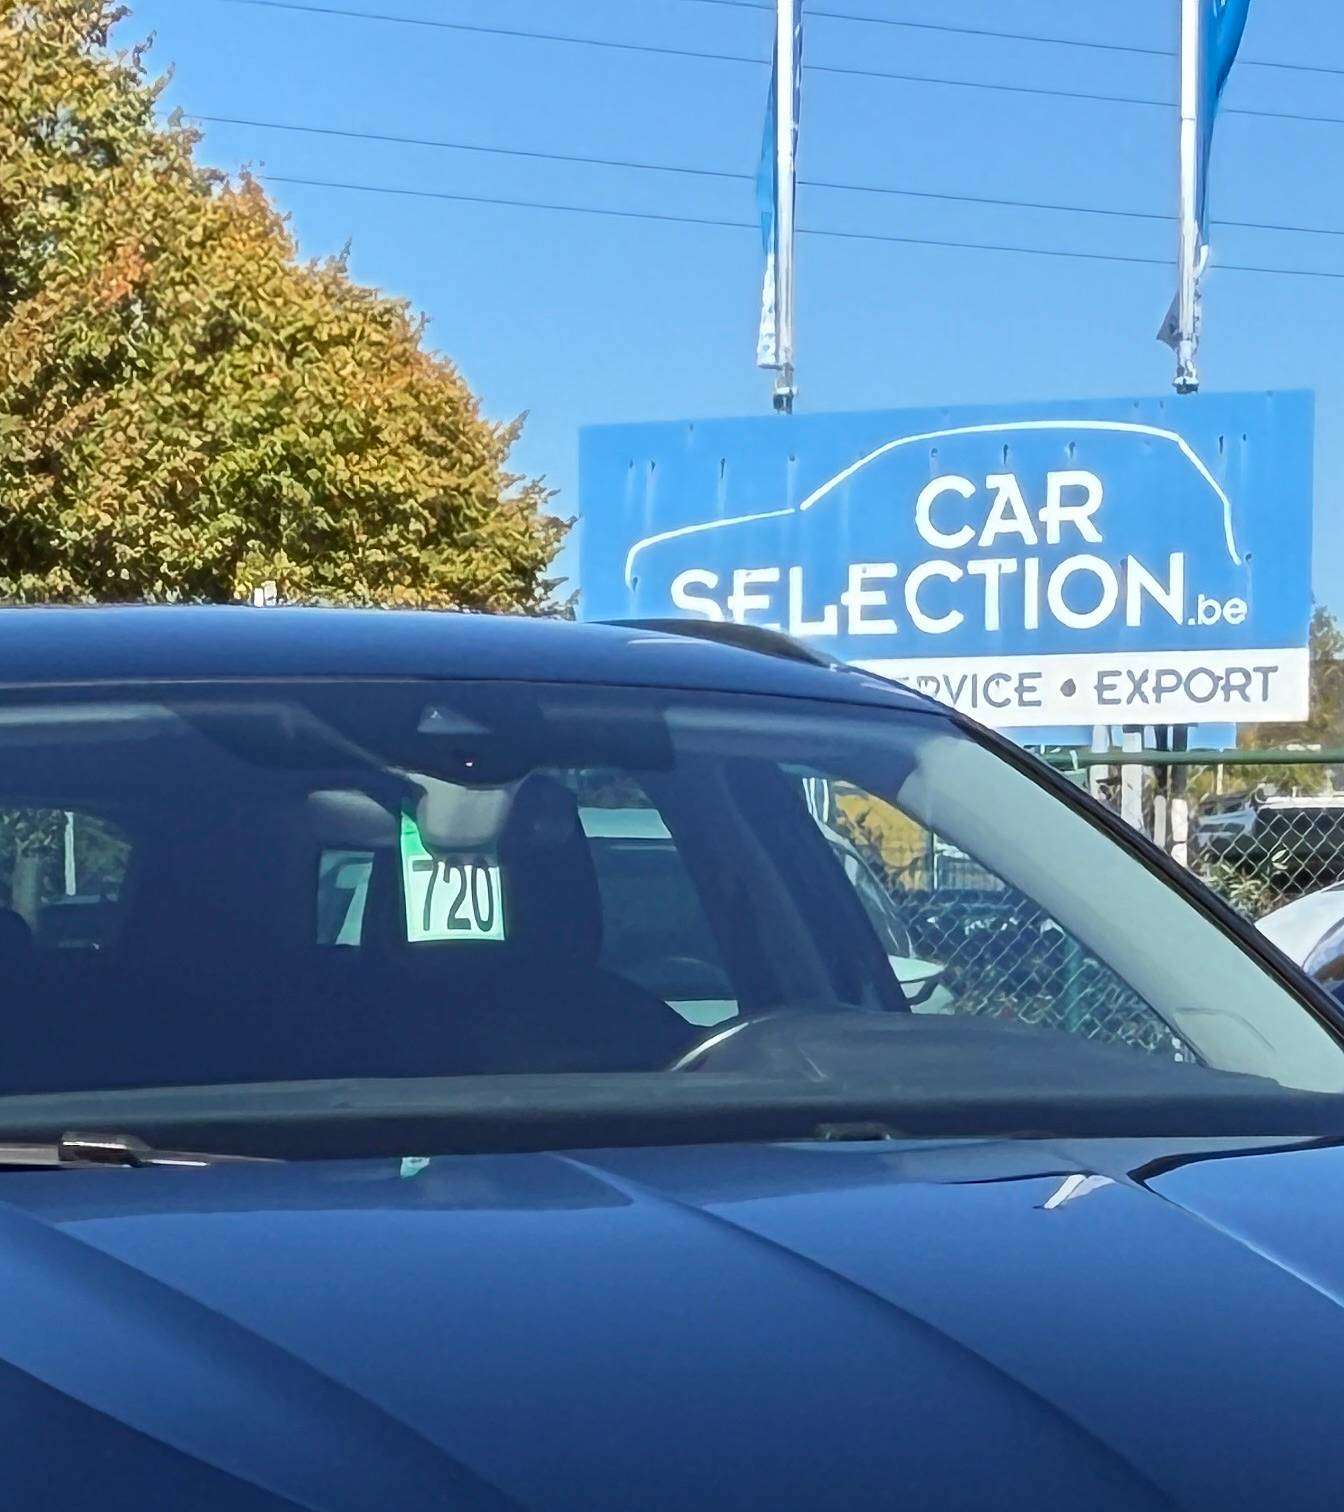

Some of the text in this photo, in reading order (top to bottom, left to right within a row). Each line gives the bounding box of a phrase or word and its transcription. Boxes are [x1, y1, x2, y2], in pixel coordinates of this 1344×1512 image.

[914, 469, 1105, 549] CAR
[896, 664, 1279, 709] RVICE EXPORT
[412, 858, 495, 932] 720
